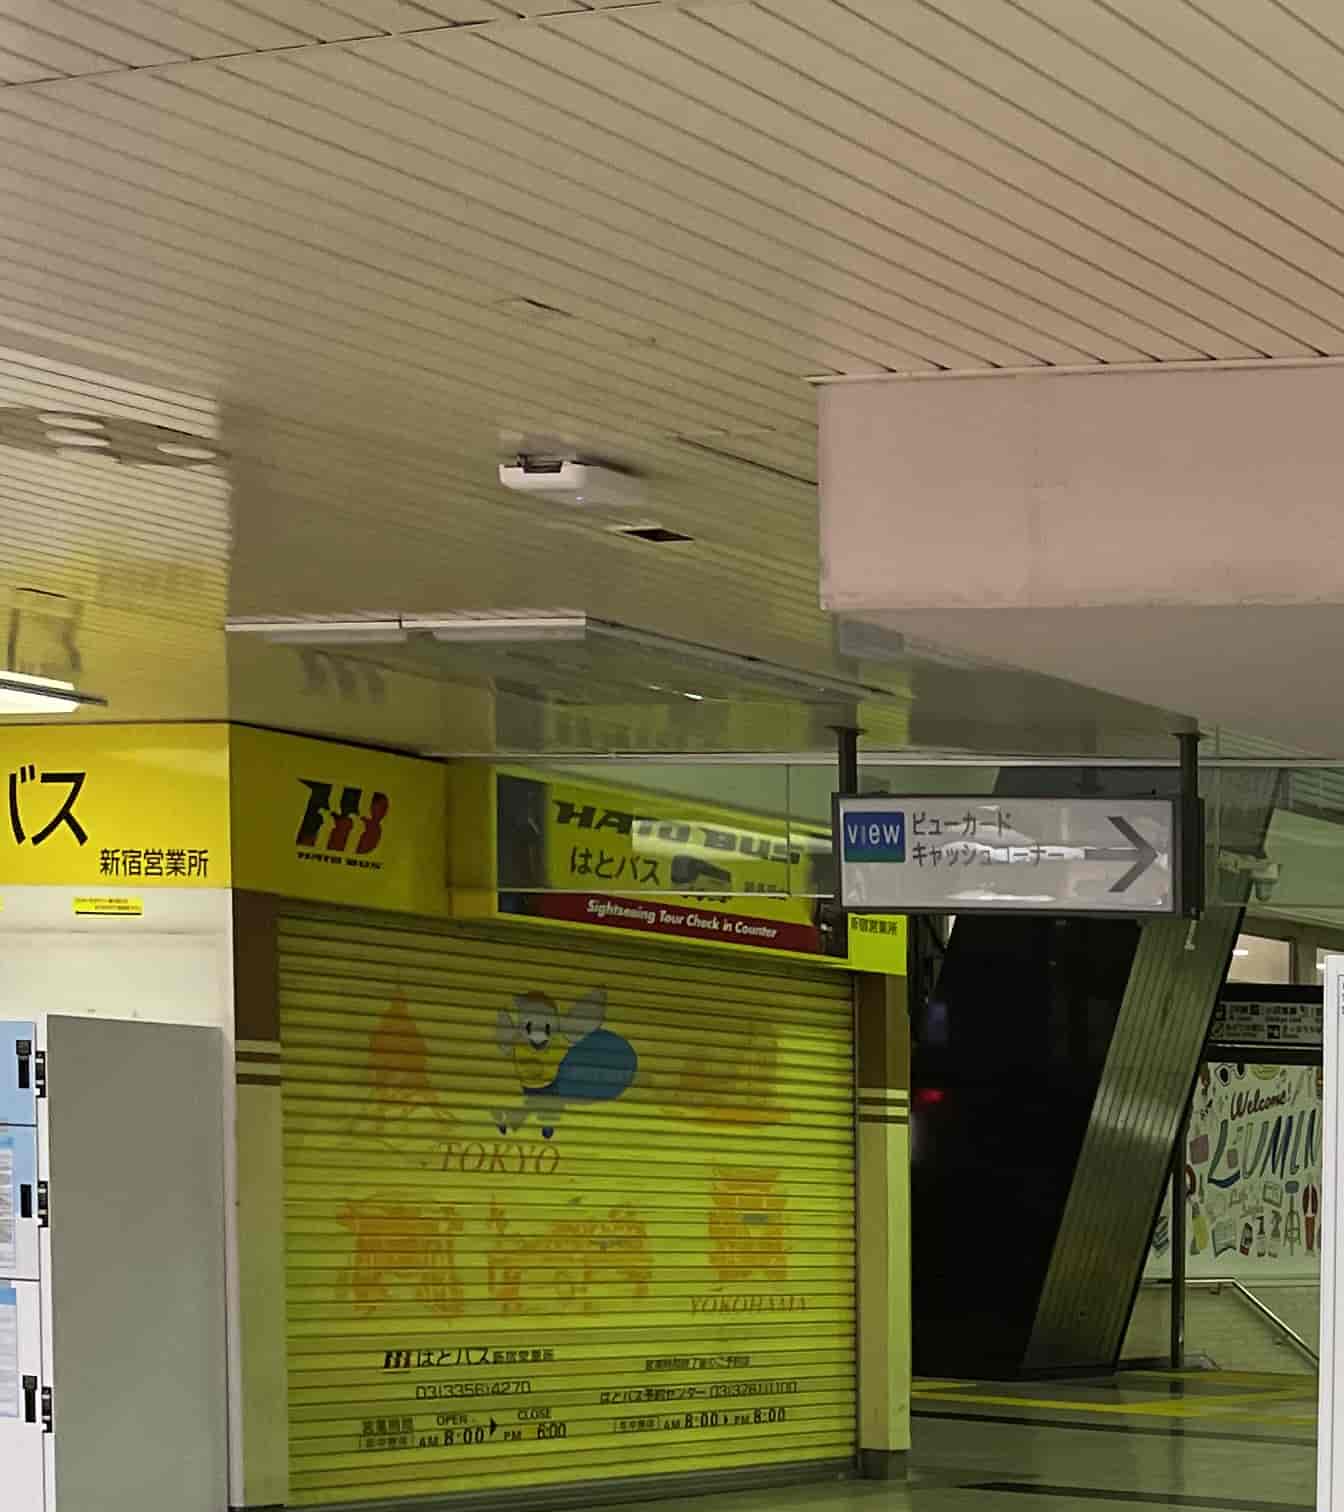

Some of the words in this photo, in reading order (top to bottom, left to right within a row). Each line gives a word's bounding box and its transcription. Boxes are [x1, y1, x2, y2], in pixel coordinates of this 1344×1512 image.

[8, 762, 89, 848] バス
[911, 810, 1014, 838] ビューカード
[99, 848, 210, 879] 新宿営業所
[569, 845, 662, 887] はとバス
[911, 841, 1067, 869] キャッシュコーナー
[586, 899, 657, 926] Sightseeing
[658, 911, 685, 928] Tour
[686, 913, 721, 933] Check
[734, 919, 778, 940] Counter
[436, 1139, 561, 1175] TOKYO
[416, 1346, 489, 1368] はとバス
[436, 1414, 469, 1427] OPEN
[516, 1406, 554, 1421] CLOSE
[419, 1436, 440, 1449] AM
